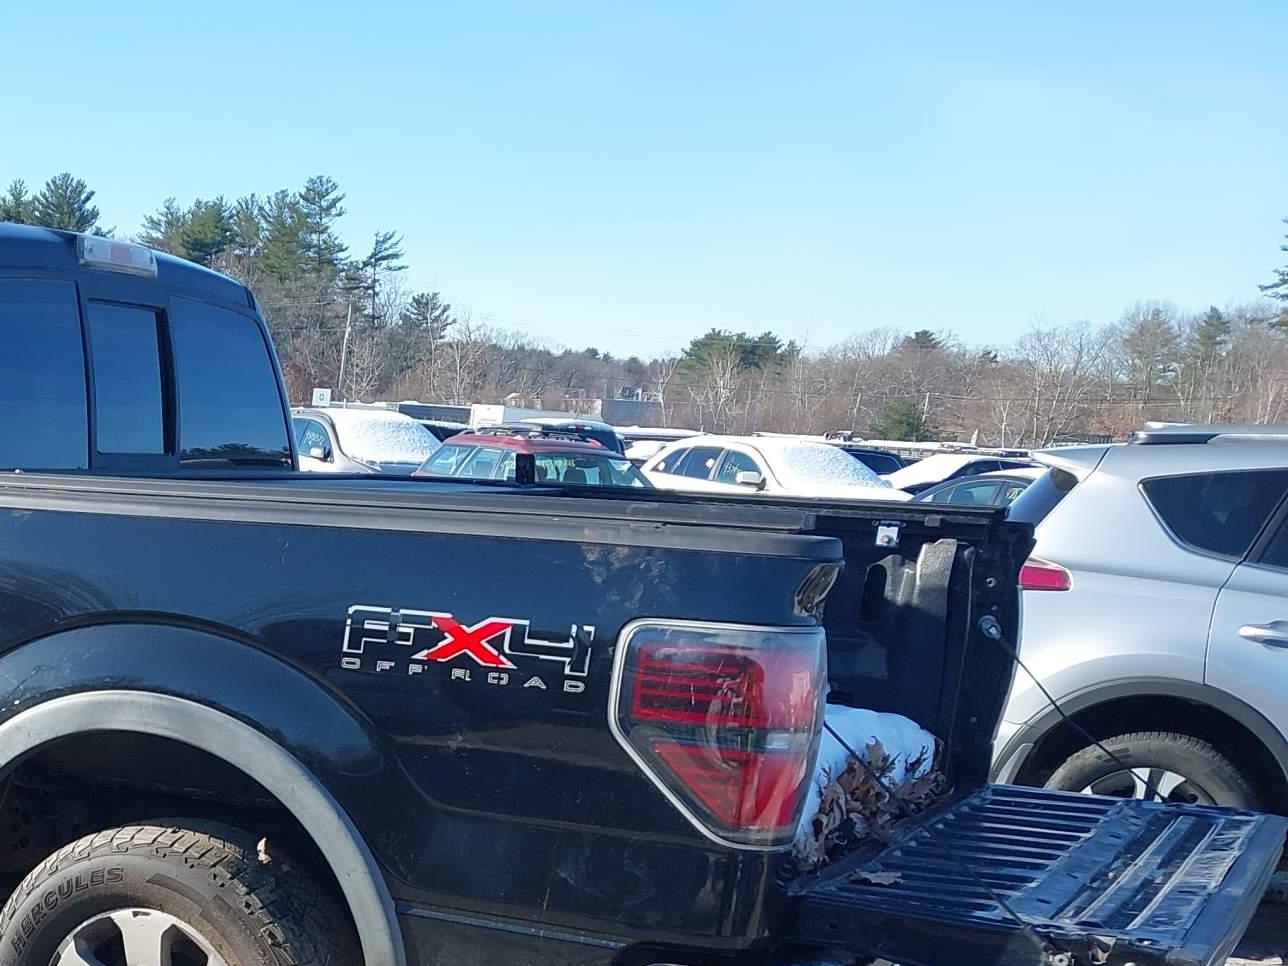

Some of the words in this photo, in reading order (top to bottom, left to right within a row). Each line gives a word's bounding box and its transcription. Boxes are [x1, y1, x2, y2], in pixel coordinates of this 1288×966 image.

[341, 657, 428, 675] OFF
[451, 668, 586, 693] ROAD
[342, 605, 595, 676] FX4
[11, 867, 124, 957] HERCULES
